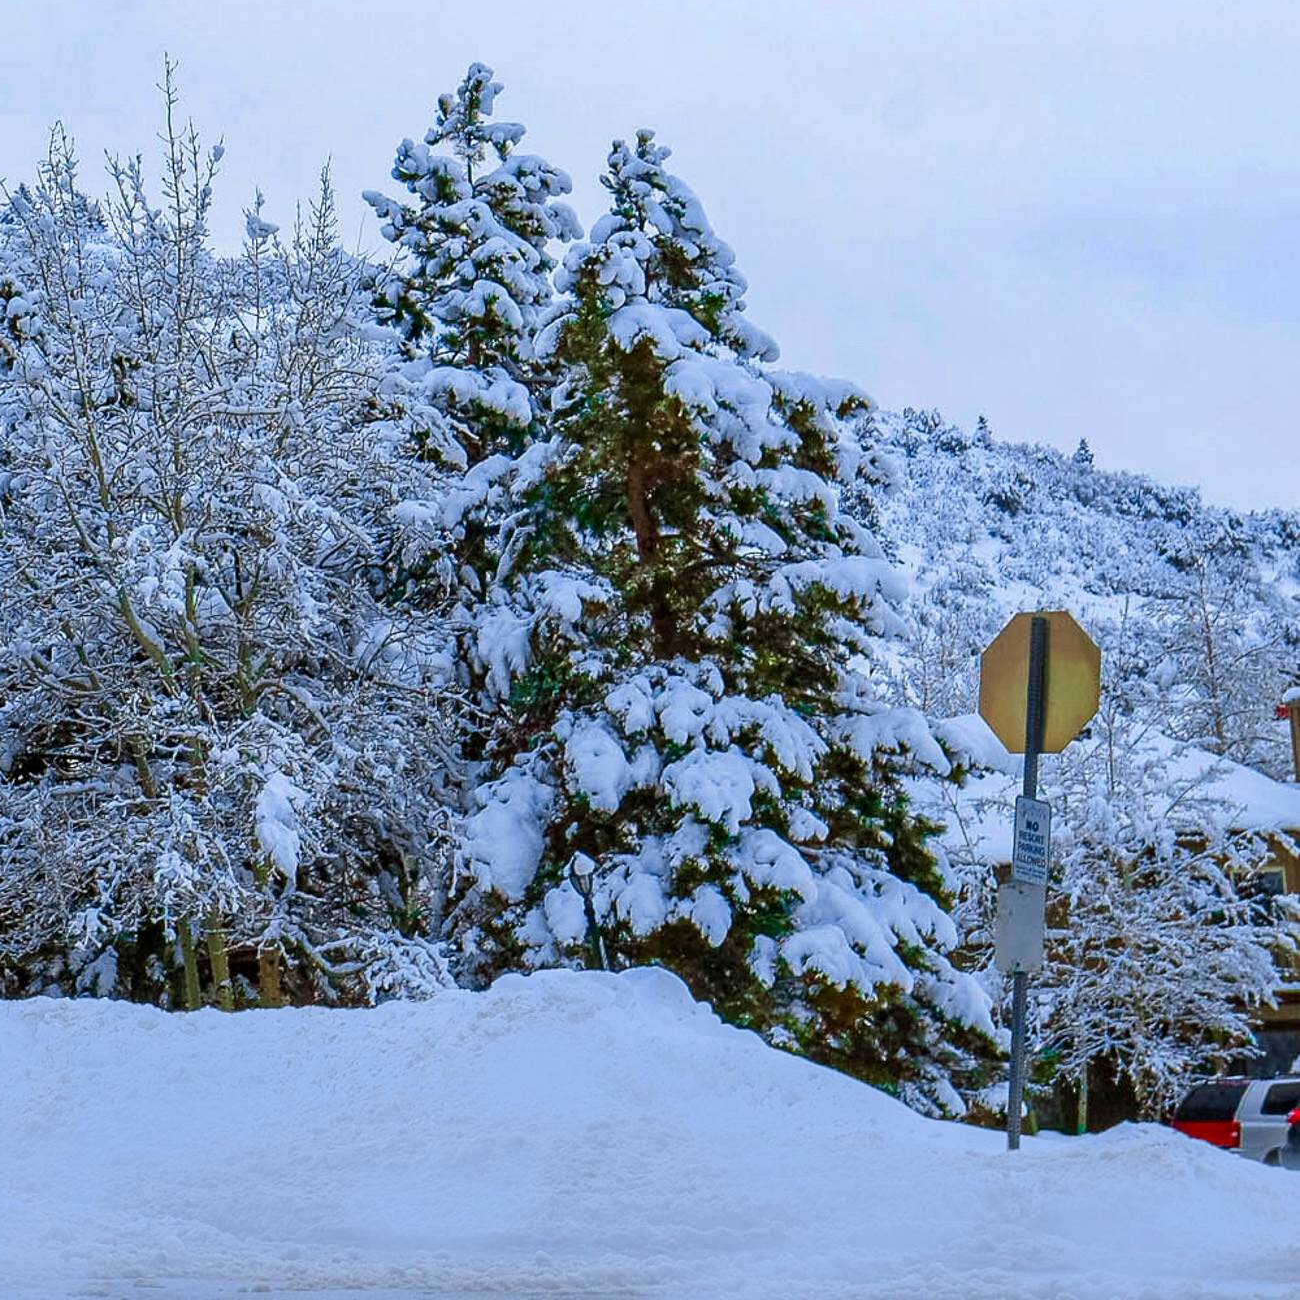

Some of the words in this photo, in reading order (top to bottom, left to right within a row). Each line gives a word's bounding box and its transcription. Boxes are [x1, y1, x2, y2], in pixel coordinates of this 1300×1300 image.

[1026, 821, 1039, 832] NO
[1018, 841, 1045, 857] PARKING
[1016, 853, 1046, 868] ALLOWED
